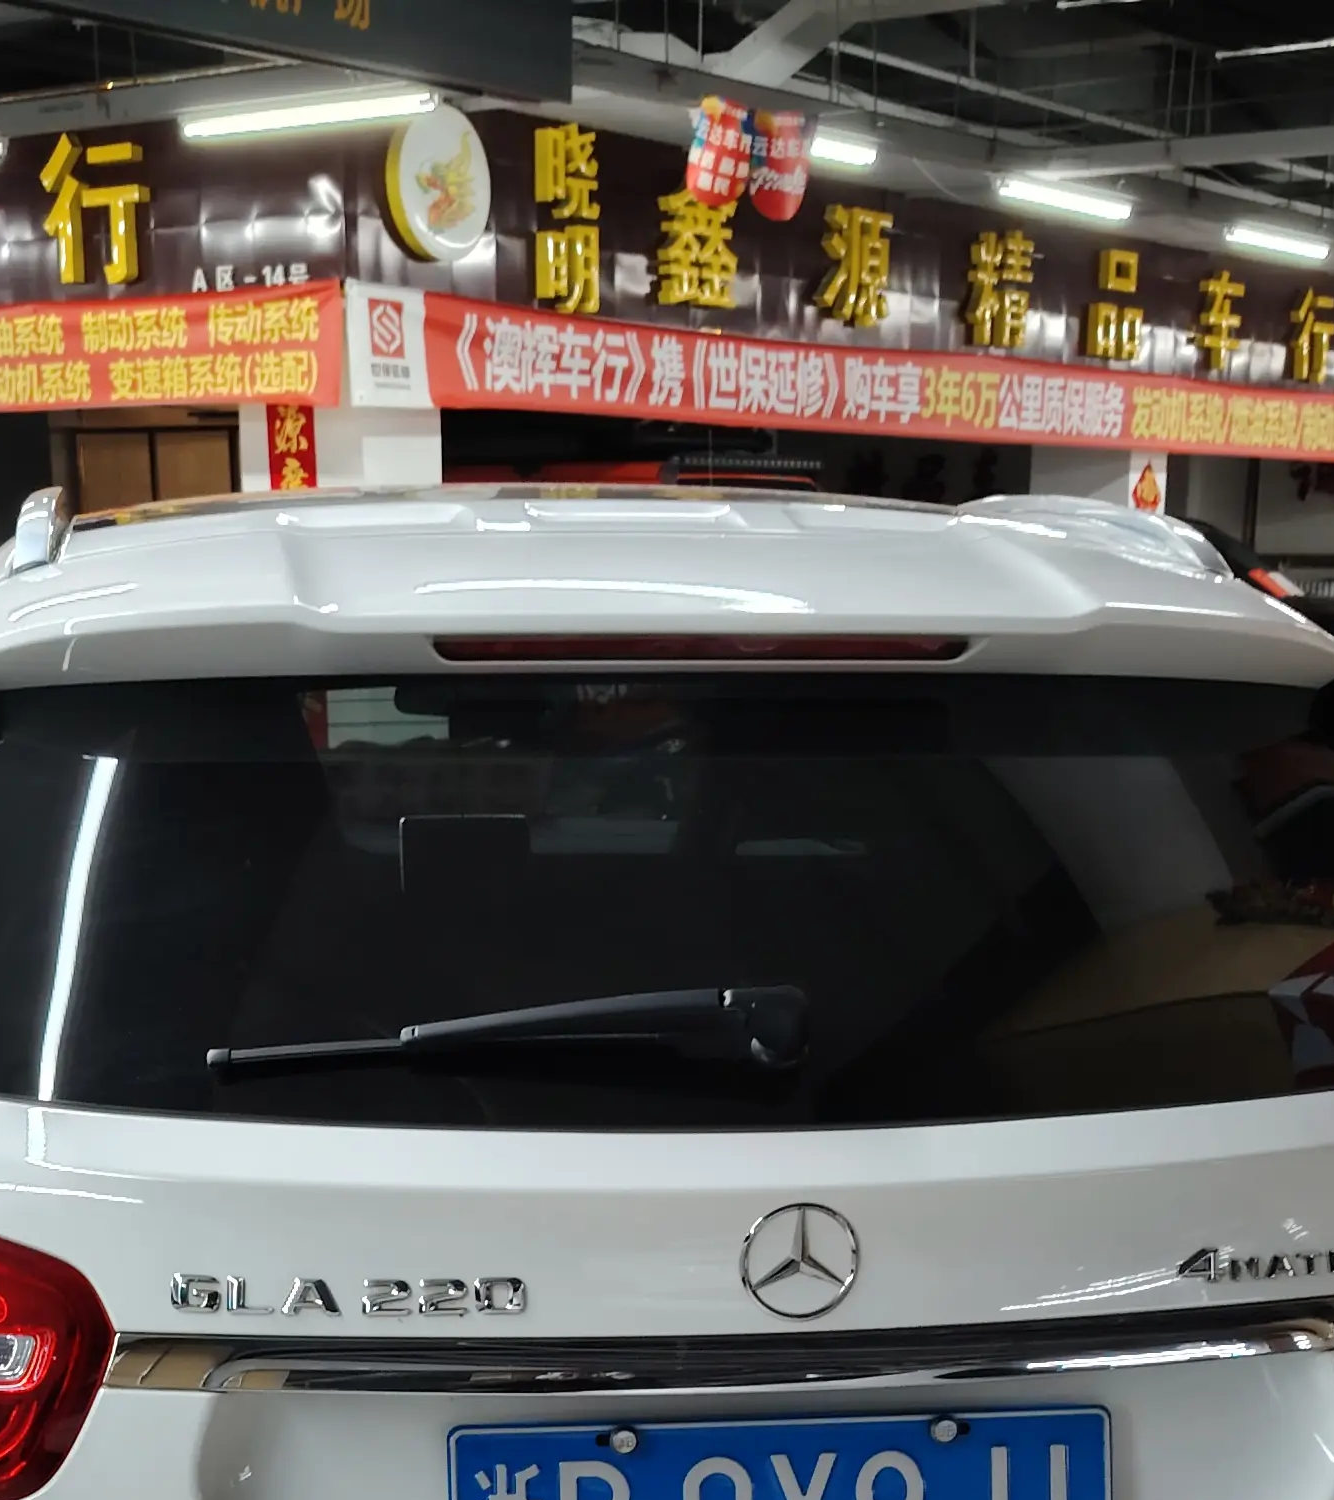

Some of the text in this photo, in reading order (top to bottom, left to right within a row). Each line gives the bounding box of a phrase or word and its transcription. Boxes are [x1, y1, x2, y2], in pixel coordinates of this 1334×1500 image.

[81, 306, 187, 353] 制动系统
[208, 297, 320, 348] 传动系统
[108, 350, 319, 399] 变速箱系统(选配)
[170, 1272, 529, 1316] GLA 220
